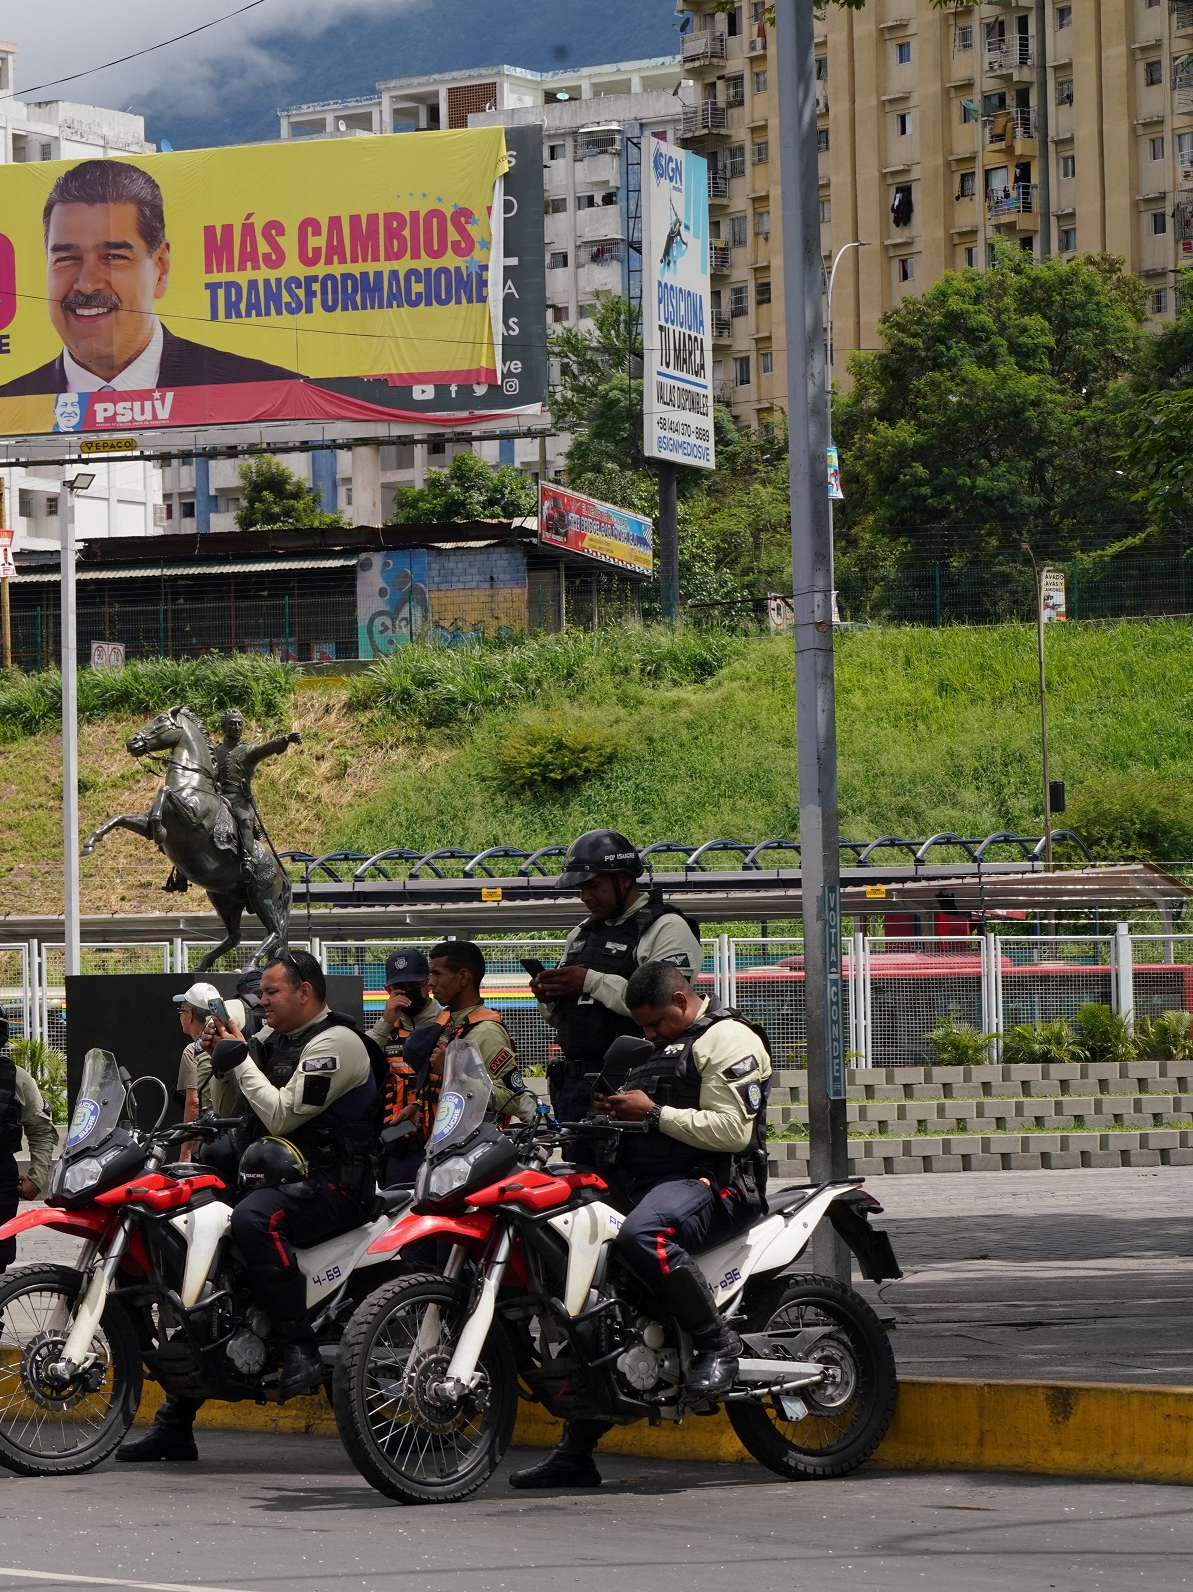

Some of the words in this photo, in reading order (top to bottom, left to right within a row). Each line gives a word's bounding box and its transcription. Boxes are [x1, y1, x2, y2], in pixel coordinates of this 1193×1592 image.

[657, 153, 683, 187] SIGN
[203, 212, 286, 274] MÁS
[297, 207, 475, 268] CAMBIOS
[657, 279, 705, 336] POSICIONA
[658, 324, 671, 369] TU
[673, 328, 706, 380] MARCA
[93, 391, 175, 423] PSUV
[656, 380, 676, 409] VALLAS
[676, 385, 709, 418] DISPONIBLES
[656, 416, 667, 432] +58
[667, 418, 681, 436] (414)
[681, 421, 692, 438] 370
[695, 426, 710, 443] 8689
[657, 435, 710, 463] @SIGNMEDIOSVE
[827, 891, 837, 963] VOTA
[829, 985, 841, 1077] CONDE
[78, 1115, 96, 1139] SUCRE
[442, 1108, 461, 1135] SUCRE
[312, 1265, 342, 1286] 4-69
